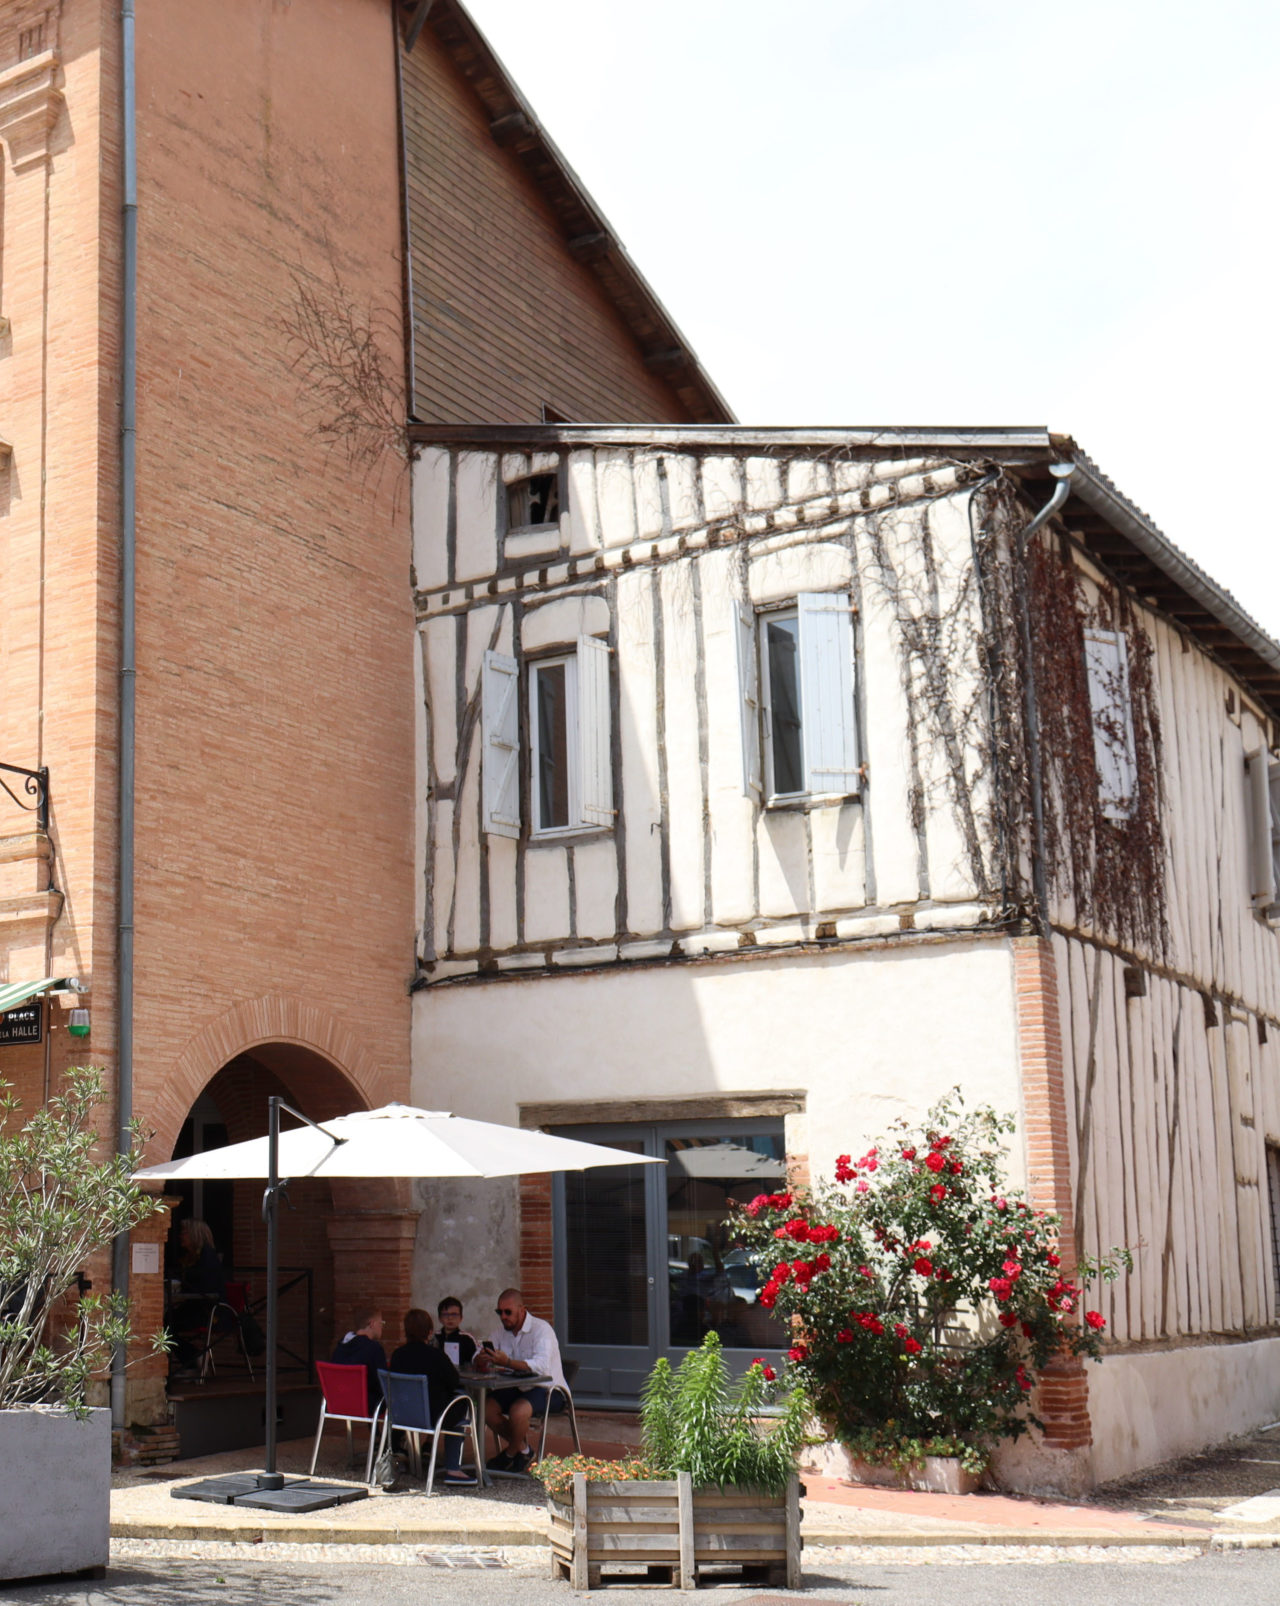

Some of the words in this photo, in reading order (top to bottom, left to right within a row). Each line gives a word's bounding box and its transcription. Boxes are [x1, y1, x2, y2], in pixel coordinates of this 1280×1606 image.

[8, 1011, 35, 1022] PLACE
[2, 1030, 9, 1038] LA
[12, 1026, 38, 1037] HALLE
